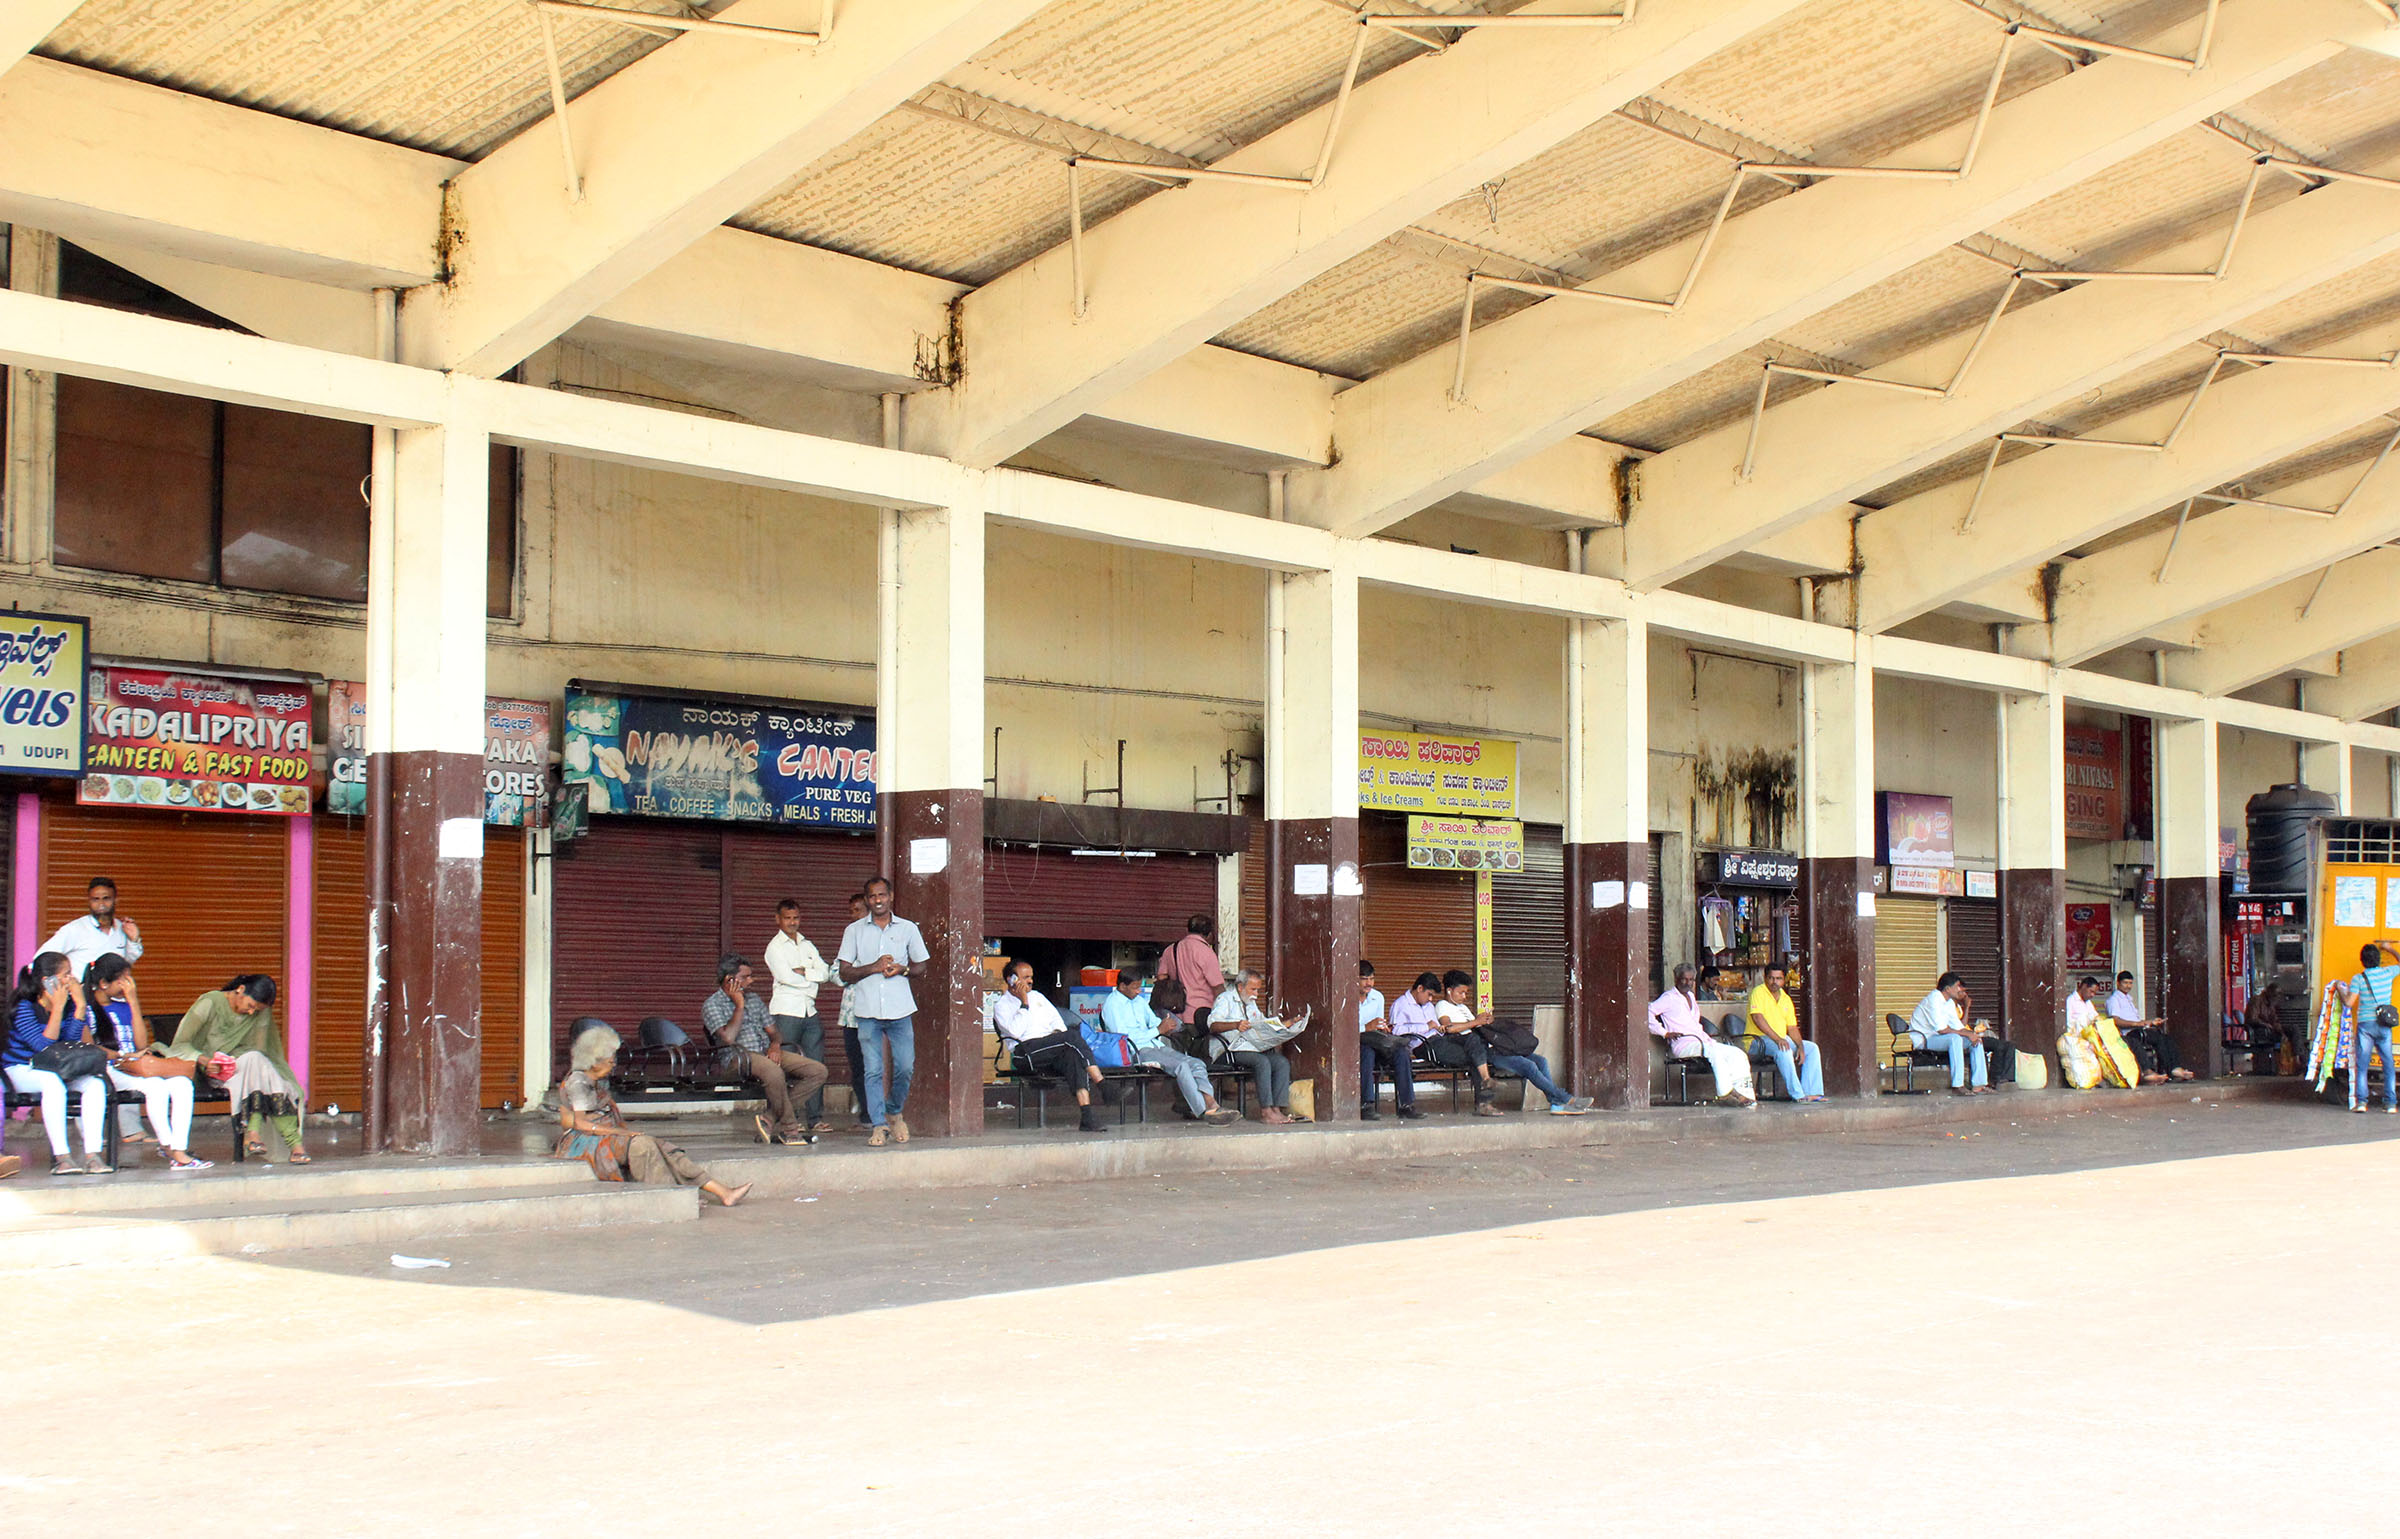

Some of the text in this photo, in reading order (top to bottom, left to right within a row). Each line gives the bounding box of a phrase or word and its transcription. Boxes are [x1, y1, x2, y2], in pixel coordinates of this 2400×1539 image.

[88, 704, 308, 752] KADALIPRIYA
[768, 715, 856, 740] ಕ್ಯಾಂಟೀನ್
[23, 745, 69, 760] UDUPI
[1417, 739, 1481, 765] ಪರಿವಾರ್
[182, 751, 199, 774] &
[205, 751, 253, 778] FAST
[259, 755, 309, 781] FOOD
[483, 769, 546, 798] ORES
[805, 786, 872, 804] PURE VEG
[634, 795, 658, 811] TEA
[669, 797, 715, 815] COFFEE
[726, 800, 773, 818] SNACKS
[783, 804, 820, 821] MEALS
[831, 807, 865, 824] FRESH
[1359, 792, 1424, 806] ks & Ice Creams
[2066, 792, 2105, 818] GING
[1724, 858, 1737, 878] ಶ್ರೀ
